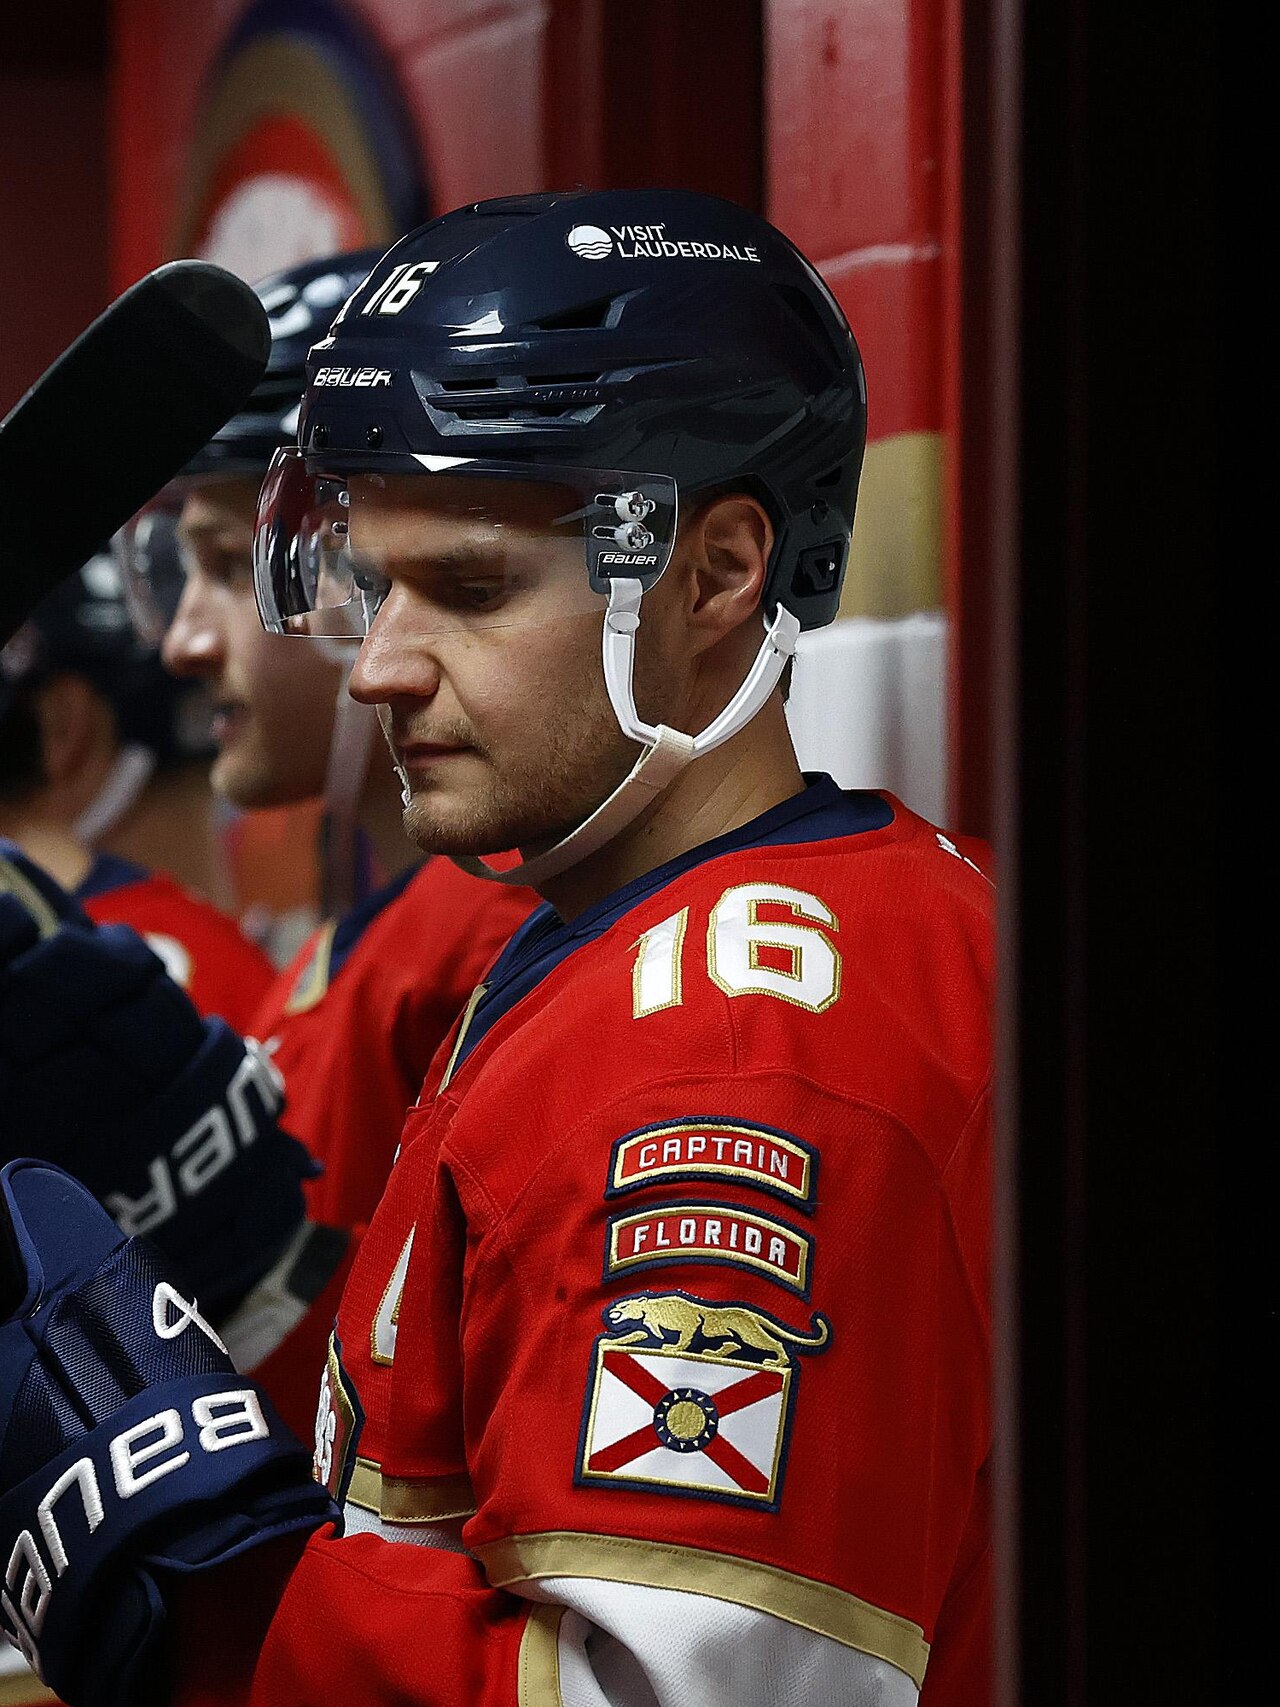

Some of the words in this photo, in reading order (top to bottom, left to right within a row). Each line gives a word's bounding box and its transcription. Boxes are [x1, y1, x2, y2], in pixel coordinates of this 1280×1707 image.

[609, 224, 665, 244] VISIT
[615, 239, 760, 263] LAUDERDALE
[361, 261, 441, 316] 16
[313, 366, 392, 388] BAUER
[602, 554, 658, 566] BAUER
[629, 881, 841, 1020] 16
[637, 1134, 790, 1179] CAPTAIN
[632, 1216, 786, 1267] FLORIDA
